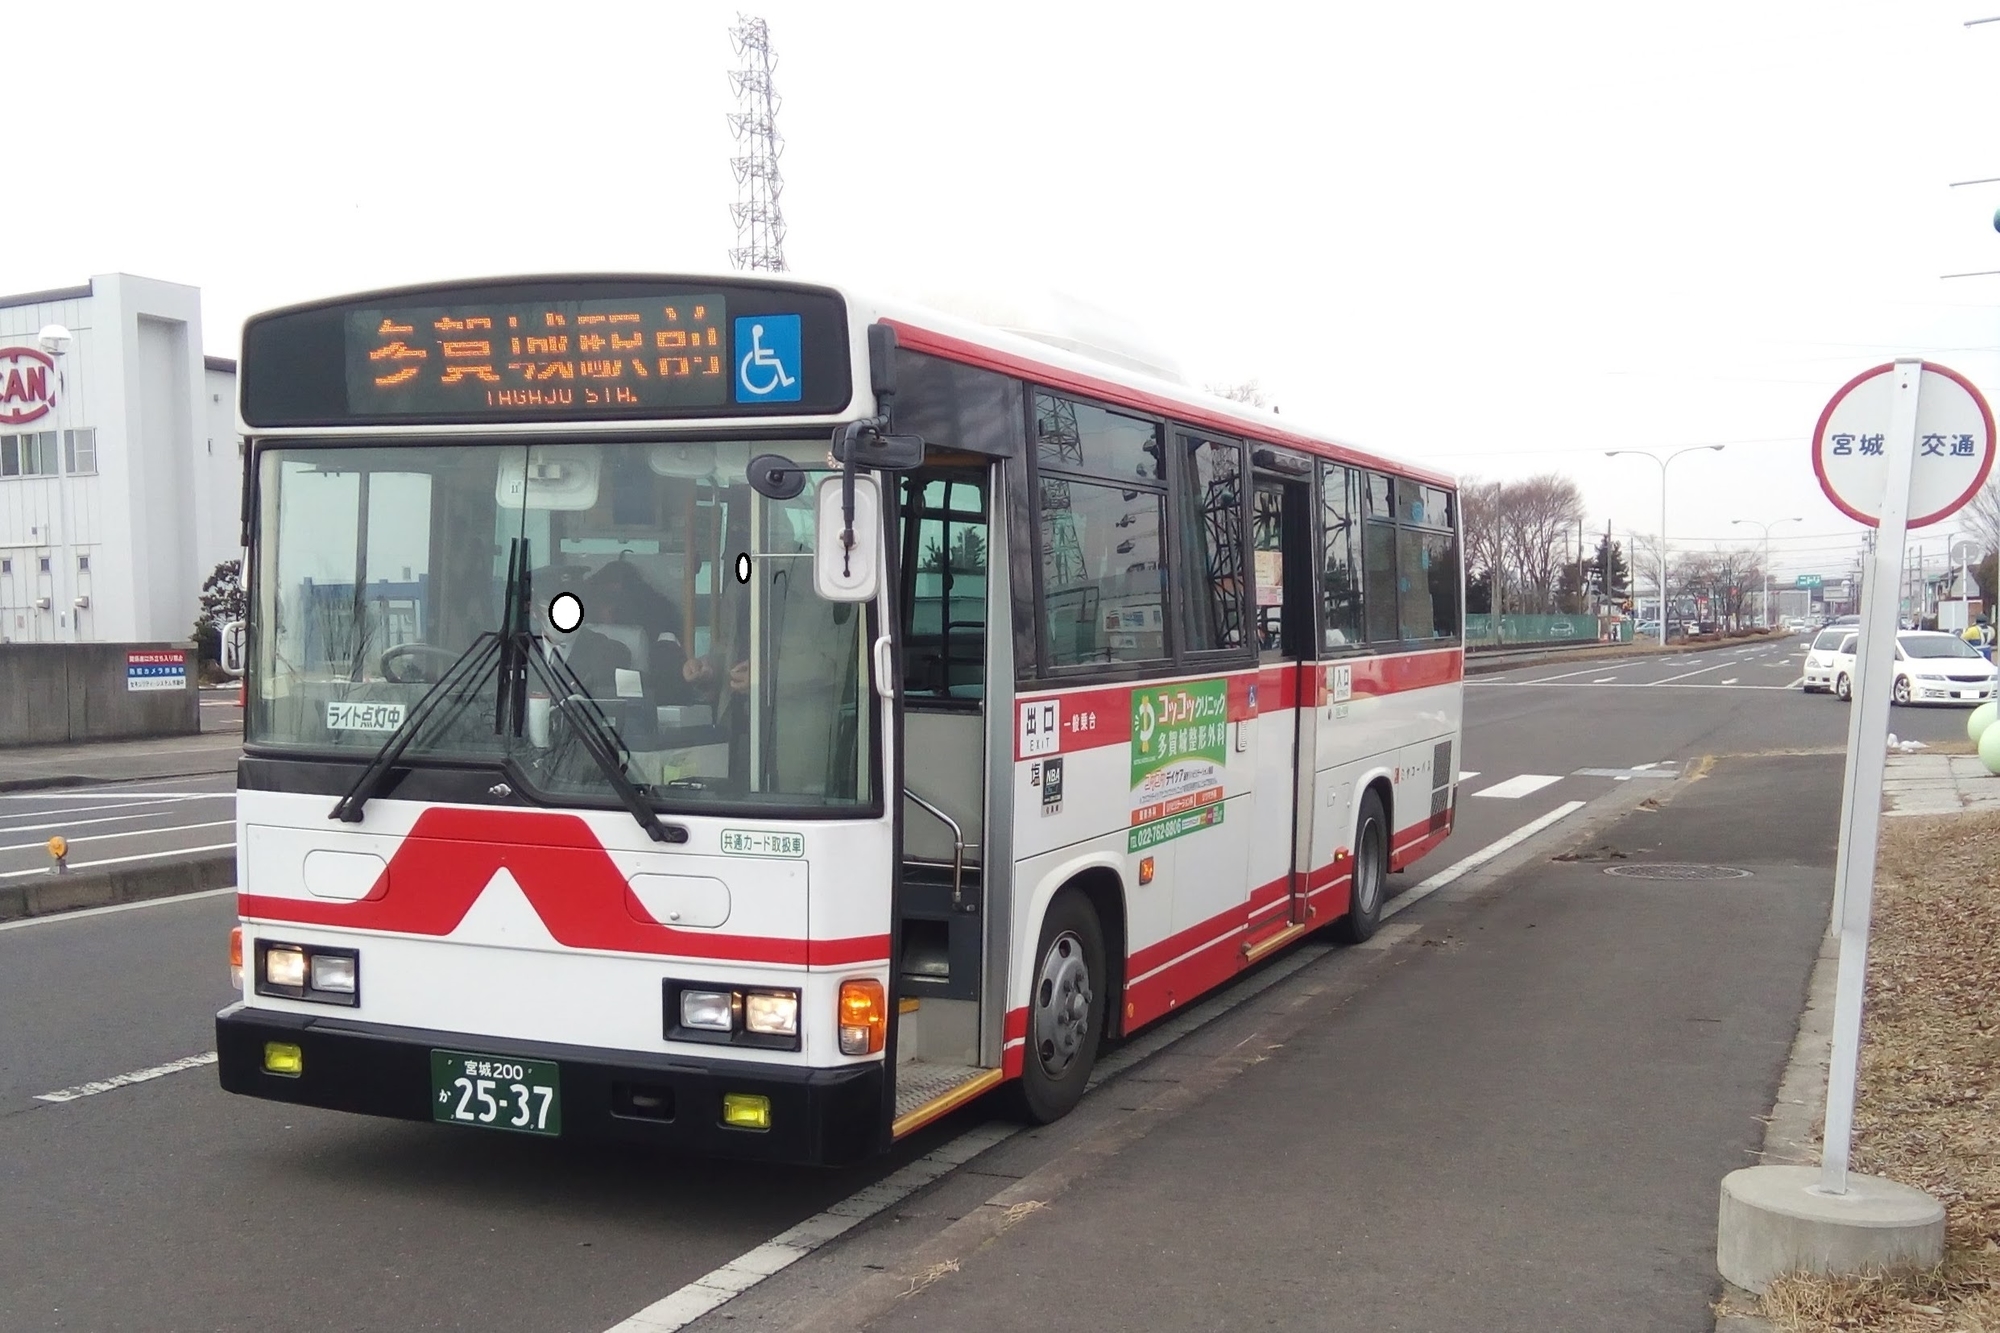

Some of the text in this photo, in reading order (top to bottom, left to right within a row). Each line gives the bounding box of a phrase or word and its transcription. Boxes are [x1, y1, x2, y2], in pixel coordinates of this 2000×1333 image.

[0, 366, 46, 403] AN
[1831, 432, 1976, 457] 宮城 交通
[1336, 669, 1349, 686] 入口
[328, 705, 401, 729] ライト点灯中
[1026, 705, 1054, 736] 出口
[1063, 712, 1097, 733] 一般乗合
[1029, 738, 1050, 752] EXIT
[1158, 722, 1225, 759] 多賀城整形外科
[1030, 763, 1041, 787] 塩
[1046, 767, 1060, 784] NBA
[724, 833, 801, 854] 共通カード取扱車
[439, 1077, 554, 1129] か 25-37
